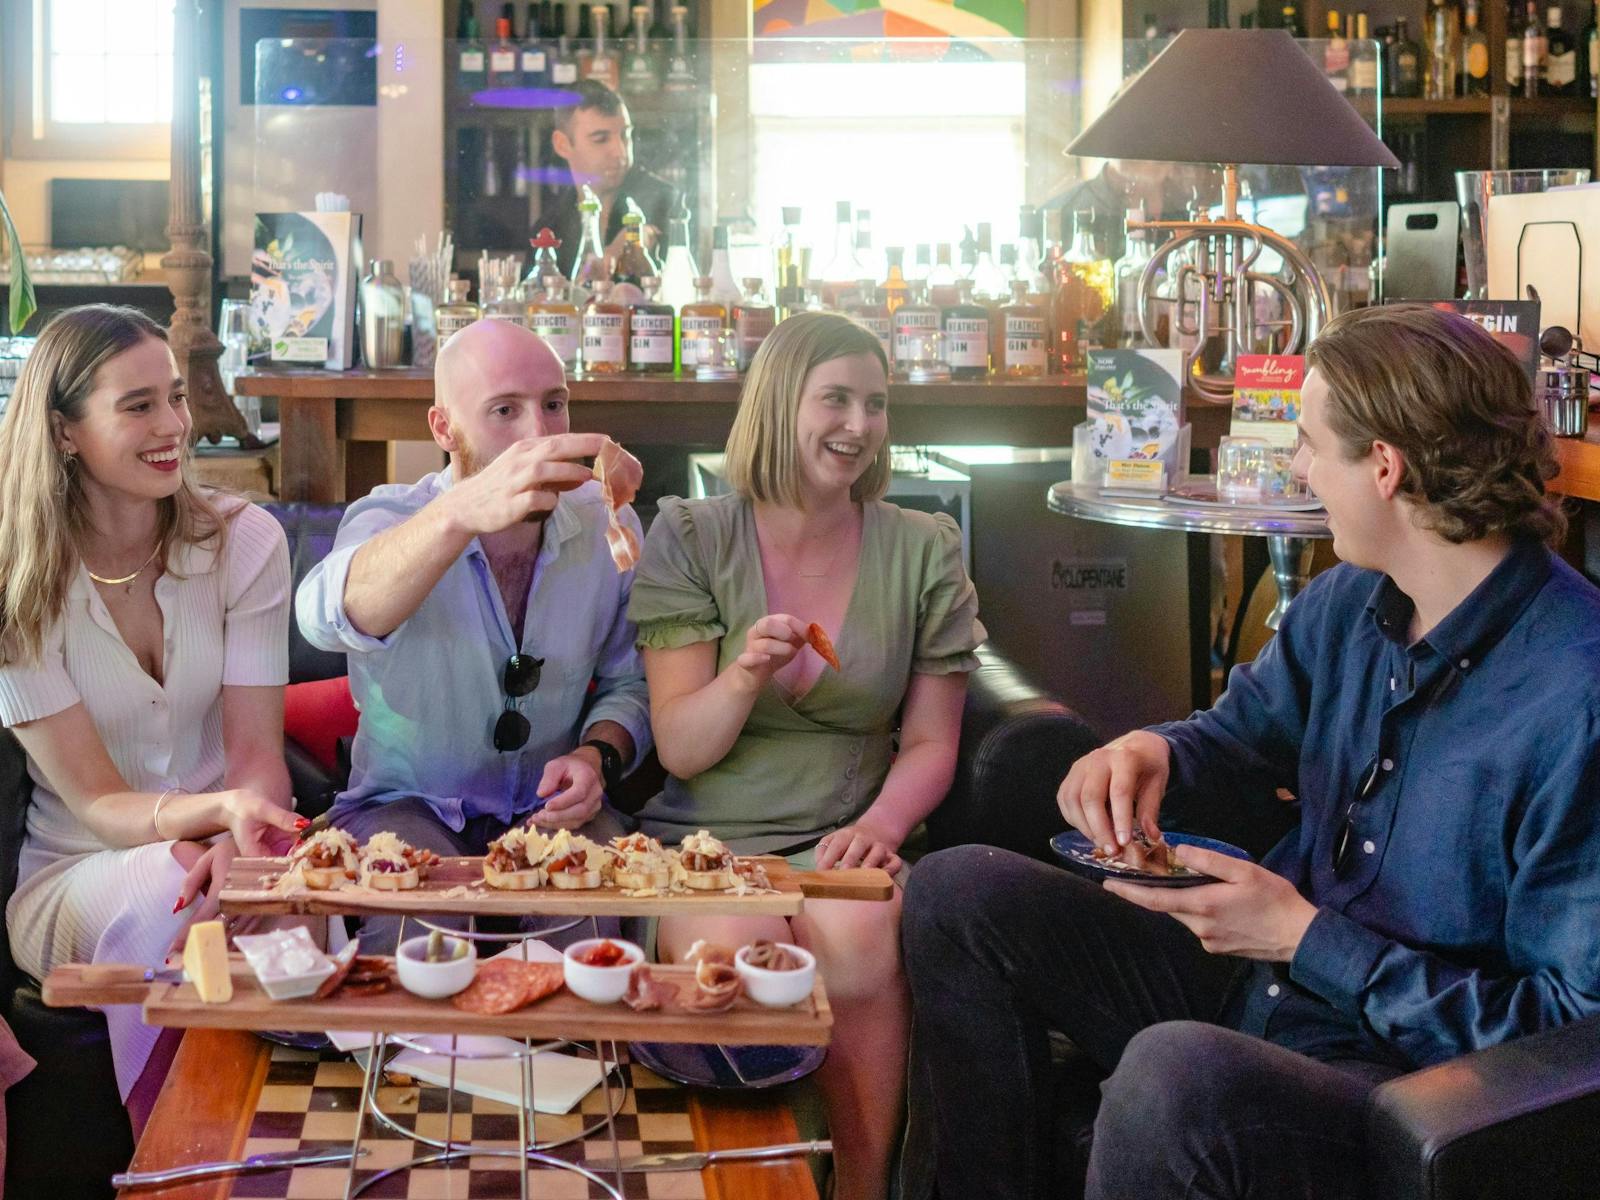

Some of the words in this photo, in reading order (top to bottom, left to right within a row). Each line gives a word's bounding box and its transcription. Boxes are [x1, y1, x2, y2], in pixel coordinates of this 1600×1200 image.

[268, 258, 292, 270] That's
[293, 258, 307, 270] the
[309, 258, 335, 272] Spirit
[584, 316, 623, 328] HEATHCOTE
[632, 317, 672, 329] HEATHCOTE
[682, 318, 720, 329] HEATHCOTE
[1484, 315, 1517, 333] GIN
[584, 336, 602, 348] GIN
[633, 338, 650, 349] GIN
[1008, 340, 1028, 351] GIN
[1104, 399, 1131, 411] That's
[1132, 399, 1148, 411] the
[1051, 561, 1126, 589] CYCLOPENTANE
